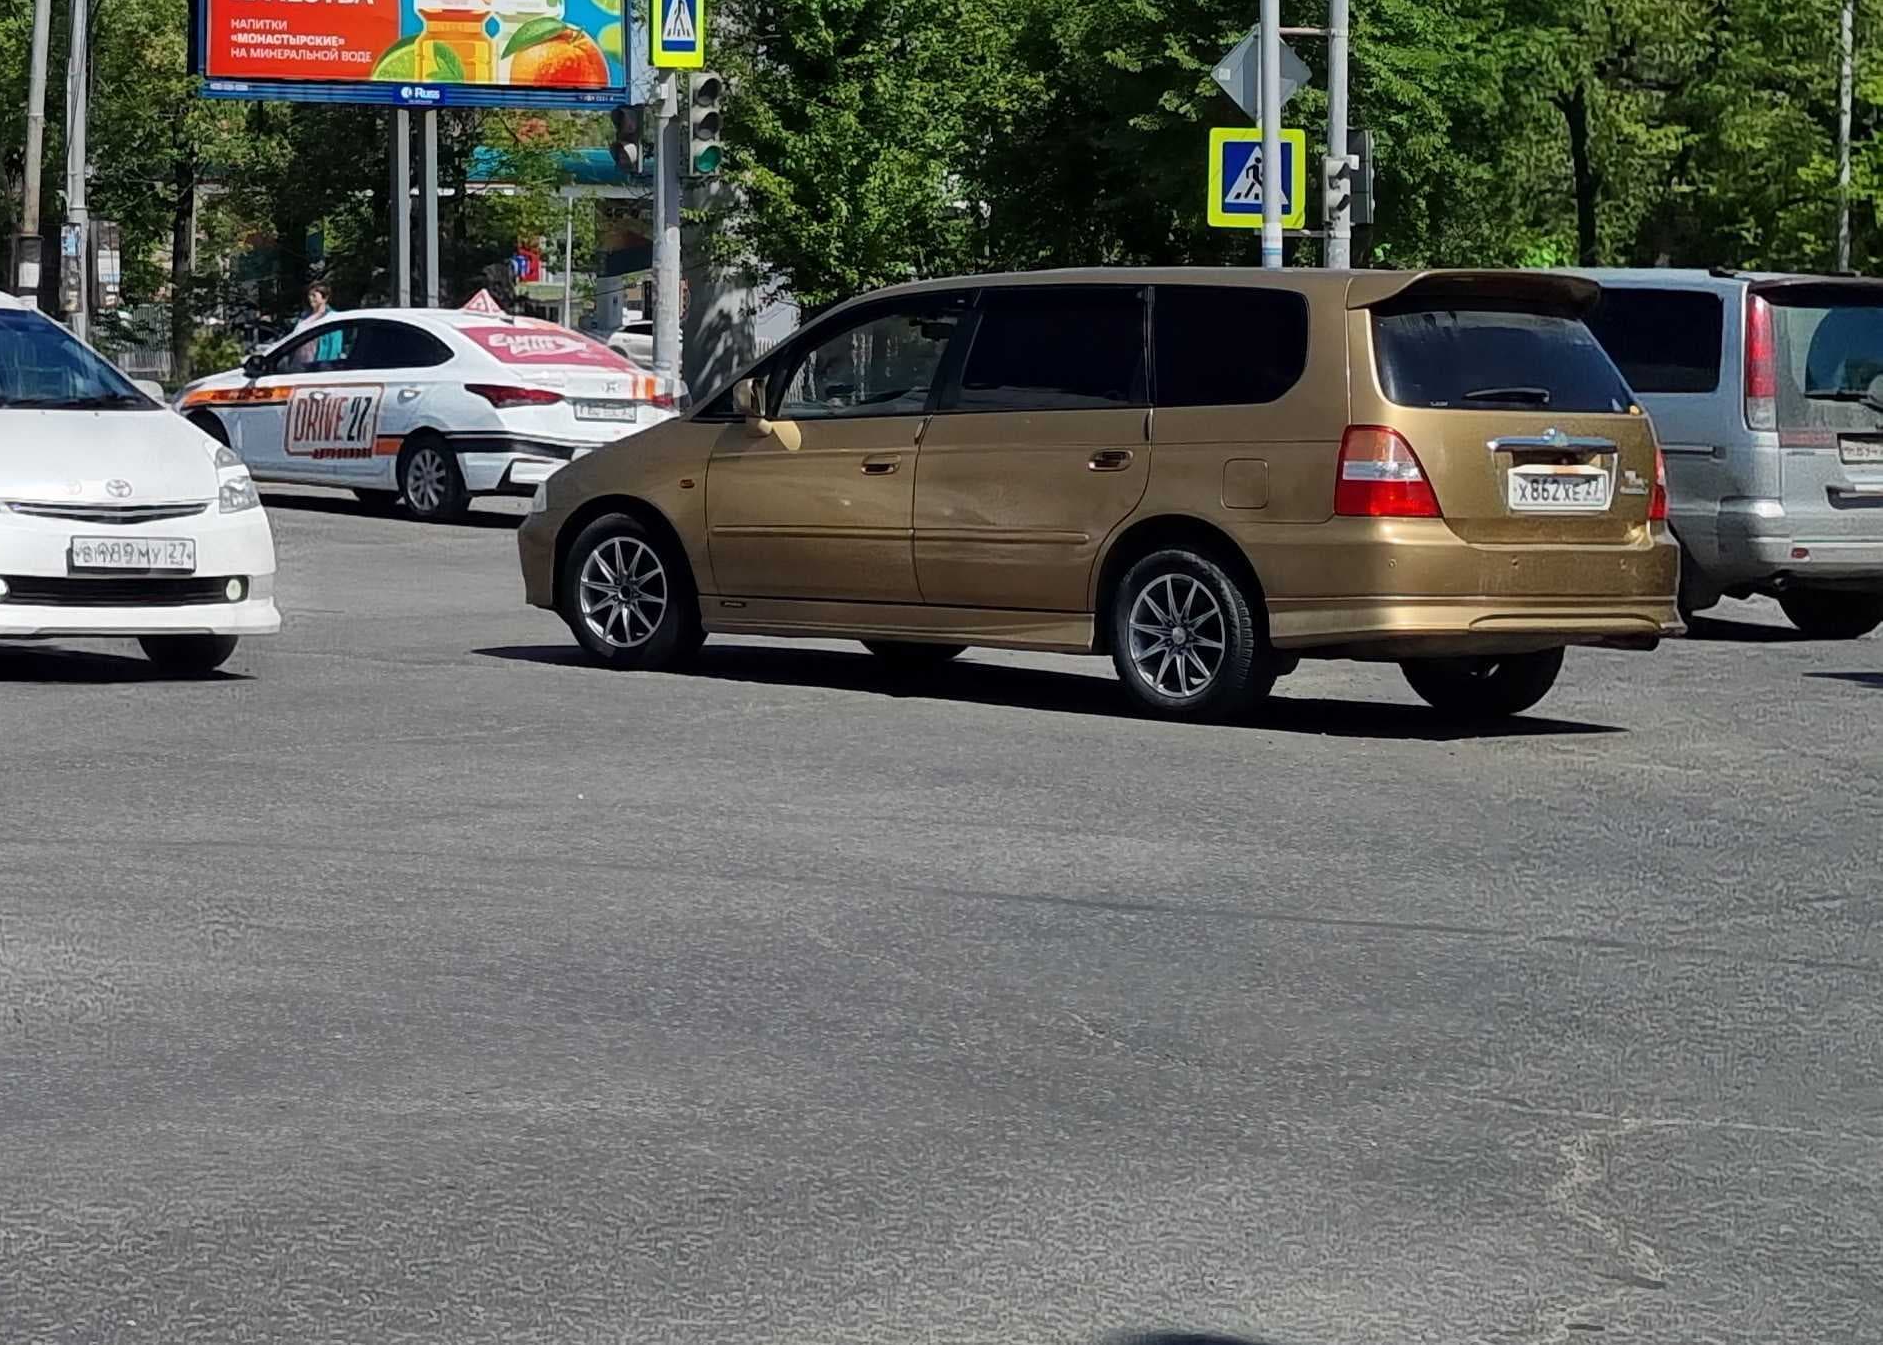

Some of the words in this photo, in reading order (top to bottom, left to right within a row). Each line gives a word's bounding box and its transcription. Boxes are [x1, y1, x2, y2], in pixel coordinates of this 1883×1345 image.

[230, 18, 288, 31] НАПИТКИ
[230, 33, 345, 47] «МОНАСТЫРСКИЕ»
[230, 48, 248, 59] НА
[250, 48, 339, 62] МИНЕРАЛЬНОЙ
[342, 51, 372, 64] ВОДЕ
[293, 397, 346, 442] DRIVE
